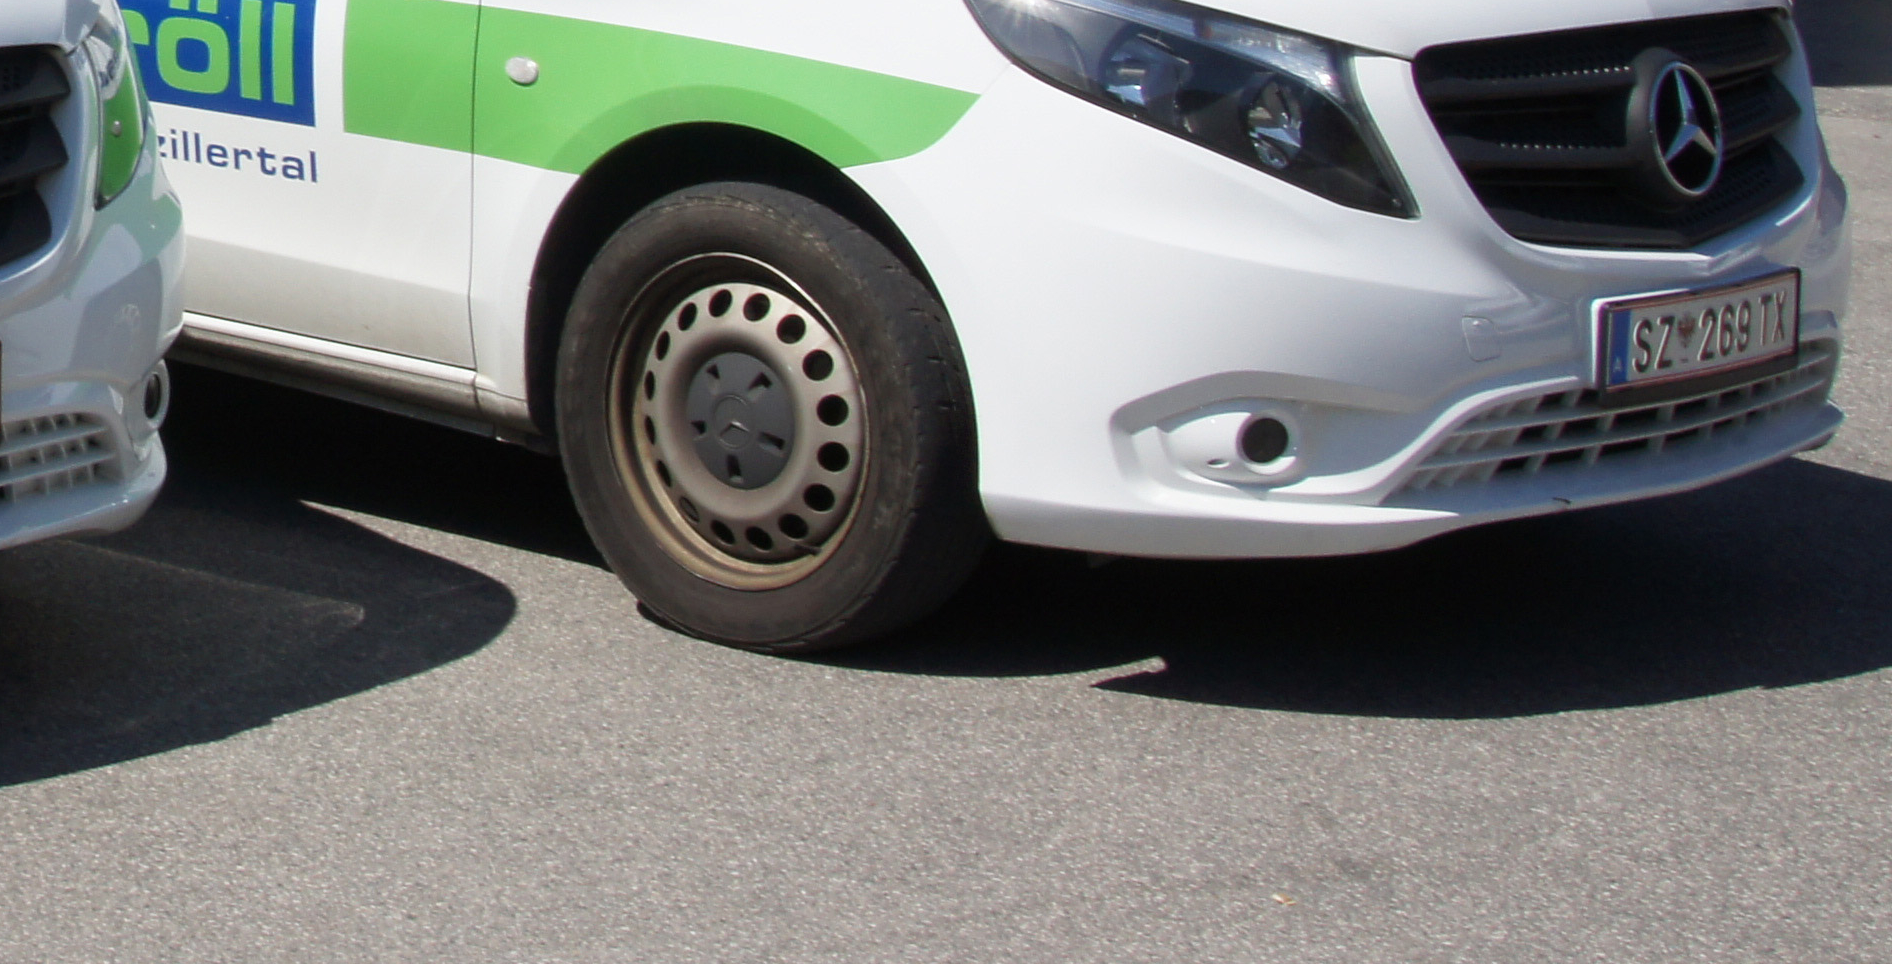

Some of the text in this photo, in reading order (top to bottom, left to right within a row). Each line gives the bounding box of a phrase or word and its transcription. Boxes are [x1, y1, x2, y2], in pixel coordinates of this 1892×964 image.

[1632, 289, 1788, 373] SZ 269 TX
[1612, 357, 1623, 373] A
